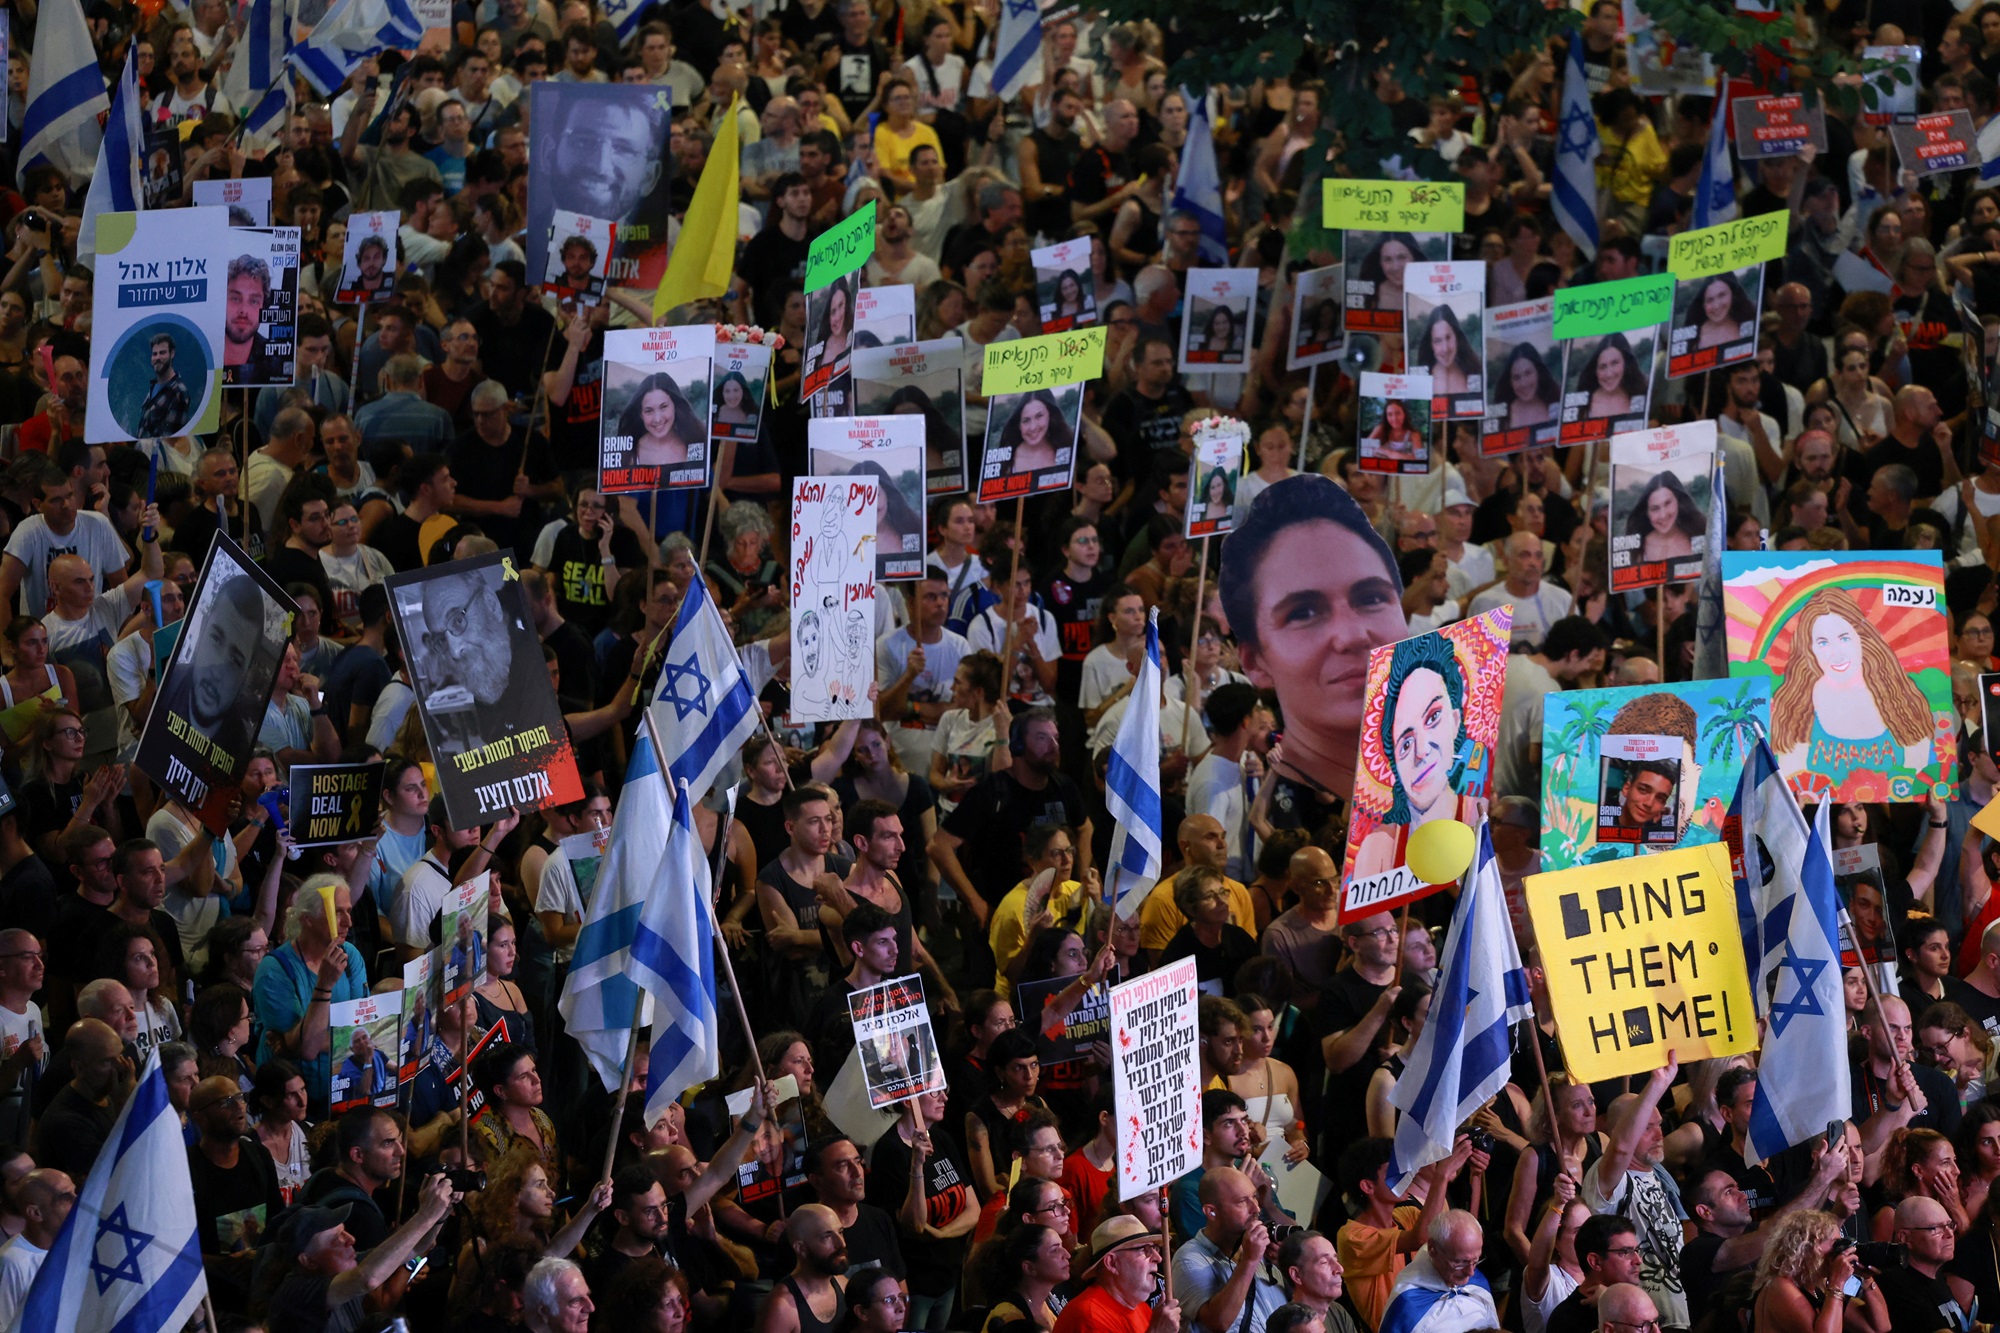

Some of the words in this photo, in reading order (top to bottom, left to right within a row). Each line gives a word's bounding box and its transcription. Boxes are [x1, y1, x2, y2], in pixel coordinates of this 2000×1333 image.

[1928, 154, 1964, 168] בחיים
[275, 230, 286, 239] אהל
[287, 230, 298, 240] אלון
[271, 244, 284, 252] ALON
[285, 244, 297, 252] OHEL
[119, 261, 159, 280] אהל
[167, 257, 207, 282] אלון
[273, 257, 283, 266] (23)
[127, 286, 176, 302] שיחזור
[182, 284, 199, 298] עד
[265, 341, 291, 356] למדינה
[642, 341, 663, 351] NAAMA
[664, 340, 677, 349] LEVY
[666, 350, 678, 360] 20
[730, 360, 742, 370] 20
[911, 355, 925, 363] LEVY
[916, 364, 927, 373] 20
[603, 436, 633, 452] BRING
[848, 430, 870, 439] NAAMA
[871, 429, 885, 438] LEVY
[877, 438, 892, 448] 20
[603, 453, 622, 468] HER
[986, 446, 1012, 464] BRING
[602, 469, 629, 486] HOME
[632, 466, 661, 484] NOW!
[984, 463, 1001, 479] HER
[982, 479, 1006, 495] HOME
[1007, 471, 1032, 490] NOW!
[1612, 533, 1641, 552] BRING
[1612, 550, 1631, 568] HER
[563, 561, 605, 584] SEAL
[1613, 565, 1639, 584] HOME
[563, 581, 606, 605] DEAL
[1887, 587, 1935, 605] נעמה
[167, 710, 188, 740] בשבי
[185, 726, 211, 756] למוות
[514, 725, 551, 754] הופקר
[210, 743, 235, 775] הופקר
[453, 747, 482, 773] בשבי
[482, 736, 514, 768] למוות
[1812, 739, 1897, 770] NAAMA
[165, 754, 192, 796] בייזר
[312, 772, 368, 794] HOSTAGE
[188, 776, 209, 809] ניק
[474, 781, 510, 814] דנציג
[510, 771, 554, 805] אלכס
[312, 796, 342, 815] DEAL
[1600, 806, 1622, 816] BRING
[309, 817, 342, 838] NOW
[1600, 816, 1613, 826] HIM
[1599, 828, 1620, 838] HOME
[1620, 828, 1642, 839] NOW!
[1350, 871, 1403, 904] תחזור
[1559, 871, 1705, 940] BRING
[1169, 962, 1195, 988] פושעי
[1570, 940, 1698, 994] THEM
[1133, 974, 1168, 1003] פילדלפי
[1113, 988, 1132, 1015] לדין
[1159, 987, 1188, 1015] בנימין
[891, 1009, 919, 1024] אלכס
[1097, 1005, 1108, 1019] את
[1127, 1004, 1158, 1030] נתניהו
[1588, 990, 1734, 1054] HOME!
[862, 1018, 889, 1032] דנציג
[1065, 1021, 1100, 1039] להפקרה
[1139, 1022, 1158, 1047] לוין
[1165, 1012, 1177, 1036] יריב
[136, 1025, 171, 1048] RING
[1165, 1024, 1195, 1053] בצלאל
[1121, 1042, 1164, 1074] סמוטריץ
[1163, 1046, 1191, 1070] איתמר
[1127, 1066, 1148, 1091] גביר
[1150, 1061, 1162, 1078] בן
[331, 1078, 350, 1092] BRING
[887, 1082, 904, 1091] אלכס
[1138, 1078, 1167, 1107] דיכטר
[1169, 1071, 1185, 1093] אבי
[331, 1091, 343, 1103] HIM
[891, 1089, 908, 1097] THEM
[1169, 1092, 1183, 1114] רון
[1143, 1102, 1168, 1126] דרמר
[1141, 1126, 1155, 1149] כץ
[1156, 1117, 1187, 1138] ישראל
[1167, 1134, 1183, 1155] אלי
[1147, 1144, 1165, 1168] כהן
[1167, 1153, 1185, 1177] מירי
[739, 1161, 759, 1175] BRING
[1147, 1162, 1165, 1186] רגב
[740, 1173, 753, 1187] HIM
